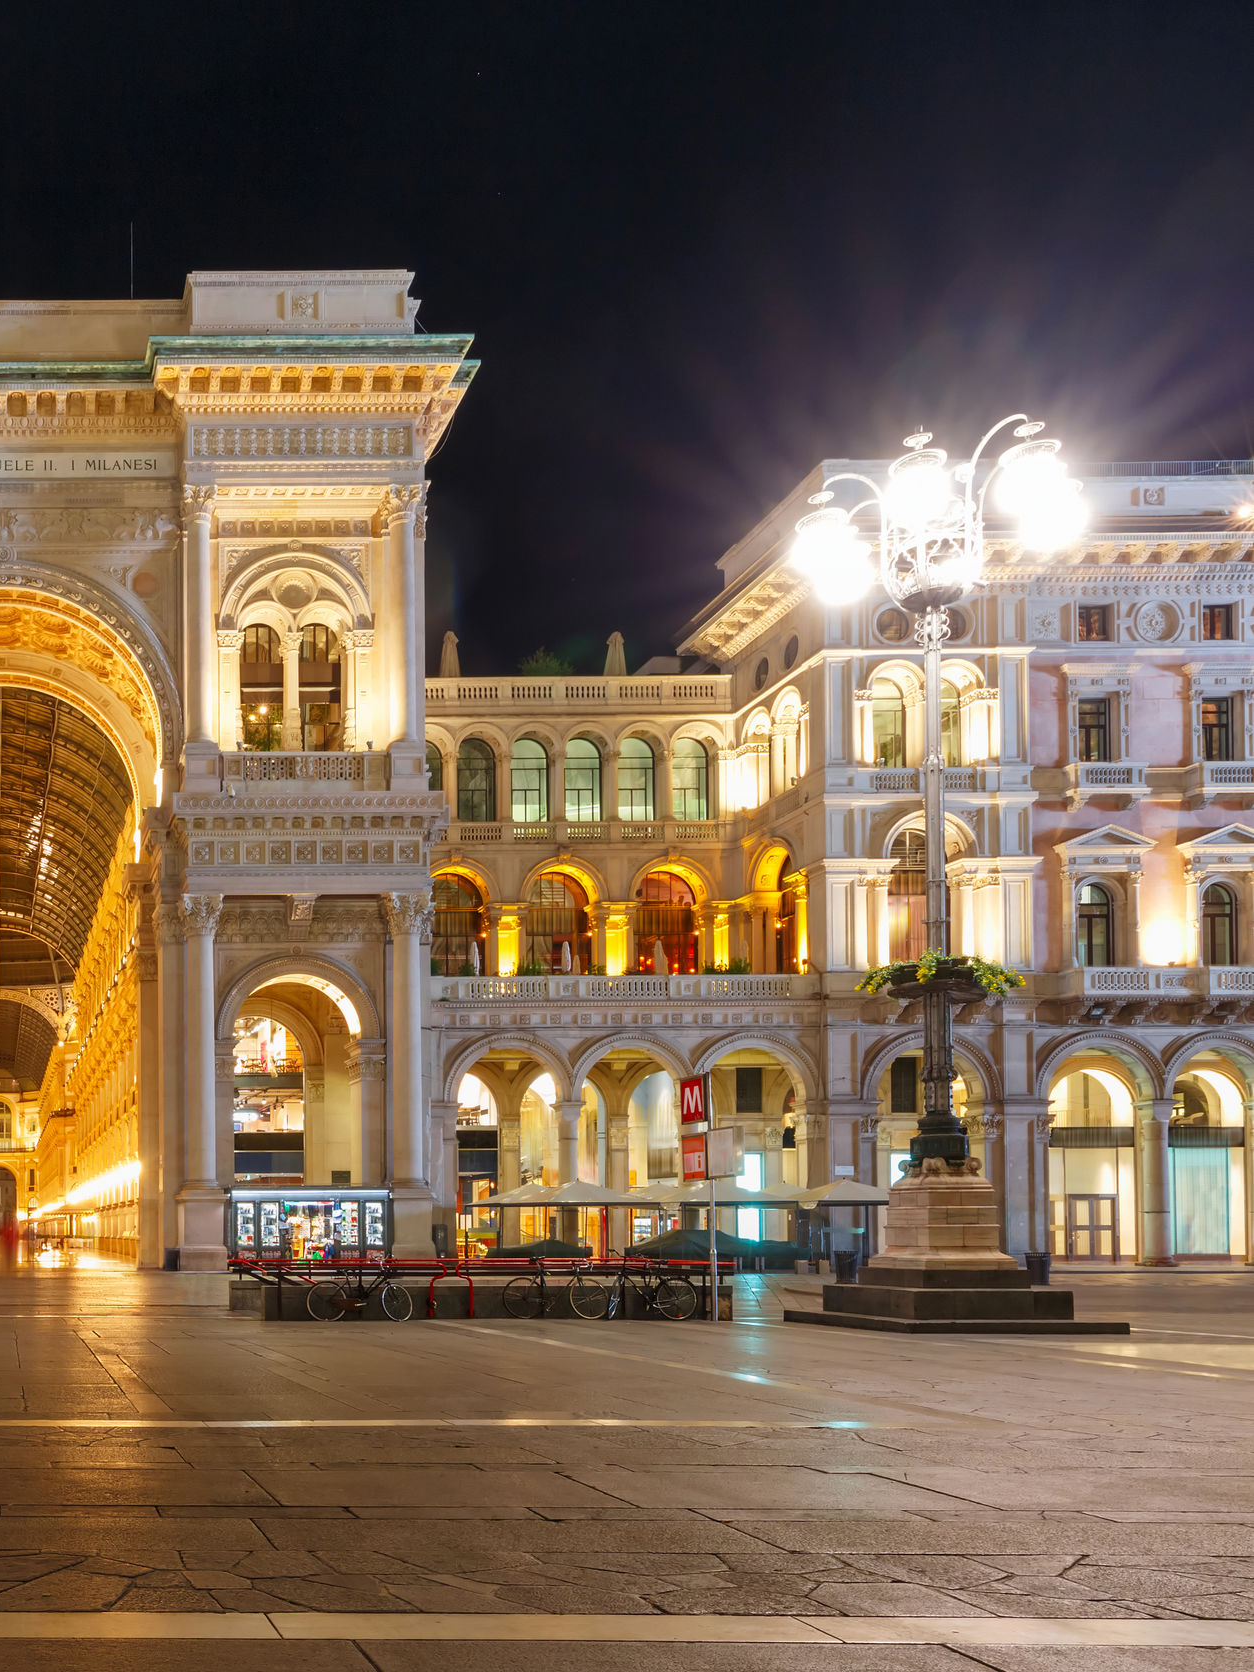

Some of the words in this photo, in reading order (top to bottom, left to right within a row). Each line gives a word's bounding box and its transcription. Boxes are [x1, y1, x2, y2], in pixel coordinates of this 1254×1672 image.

[43, 459, 58, 471] II.
[84, 458, 158, 471] MILANESI
[683, 1085, 702, 1115] M
